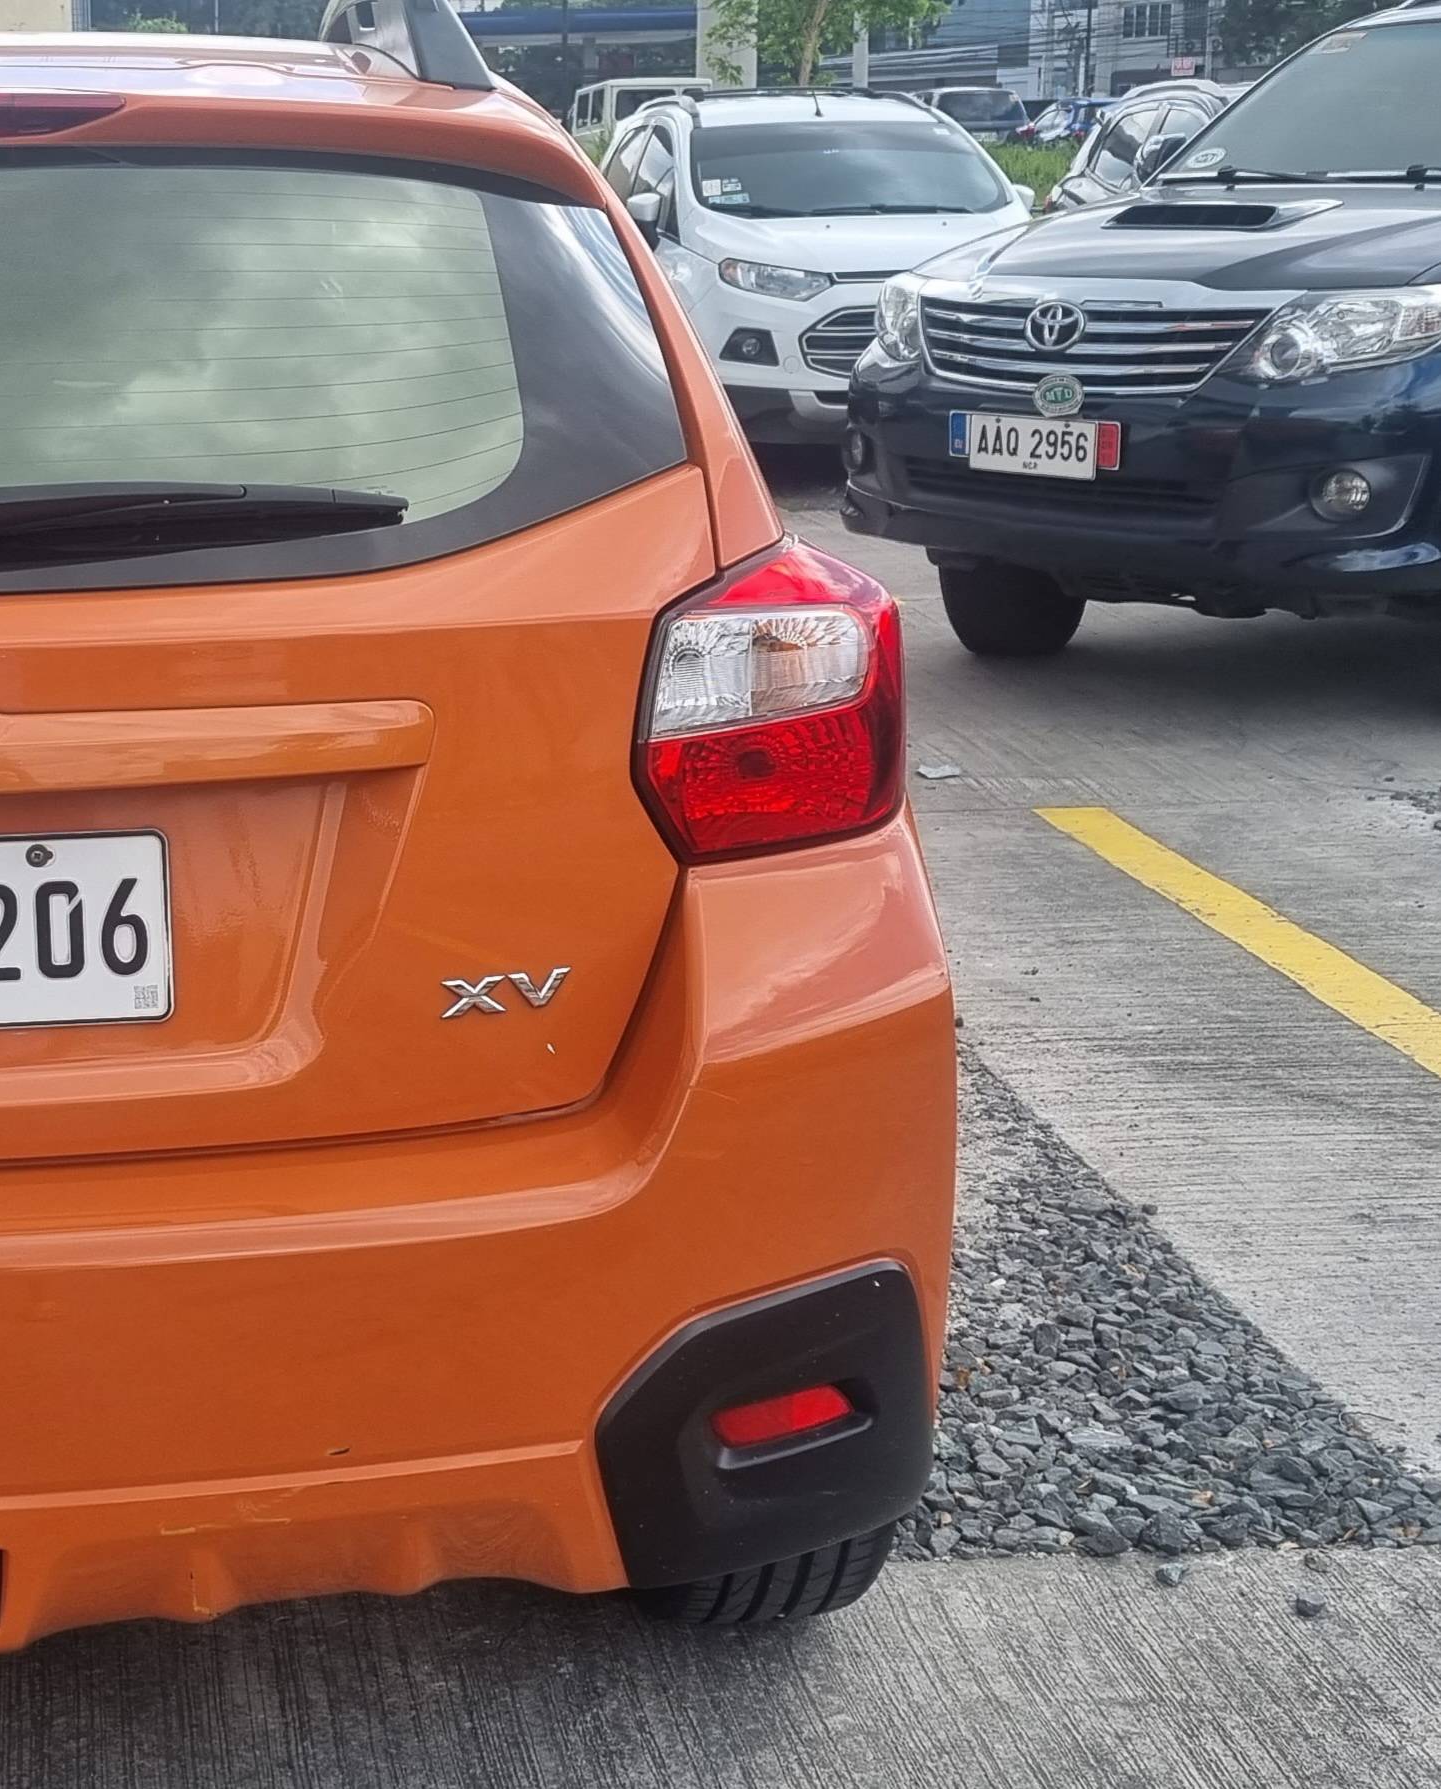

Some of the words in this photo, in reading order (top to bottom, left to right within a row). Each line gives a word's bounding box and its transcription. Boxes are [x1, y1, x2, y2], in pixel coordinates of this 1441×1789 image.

[977, 424, 1020, 456] AAQ
[1029, 429, 1089, 463] 2956
[1022, 461, 1038, 470] NCR
[440, 966, 572, 1019] XV
